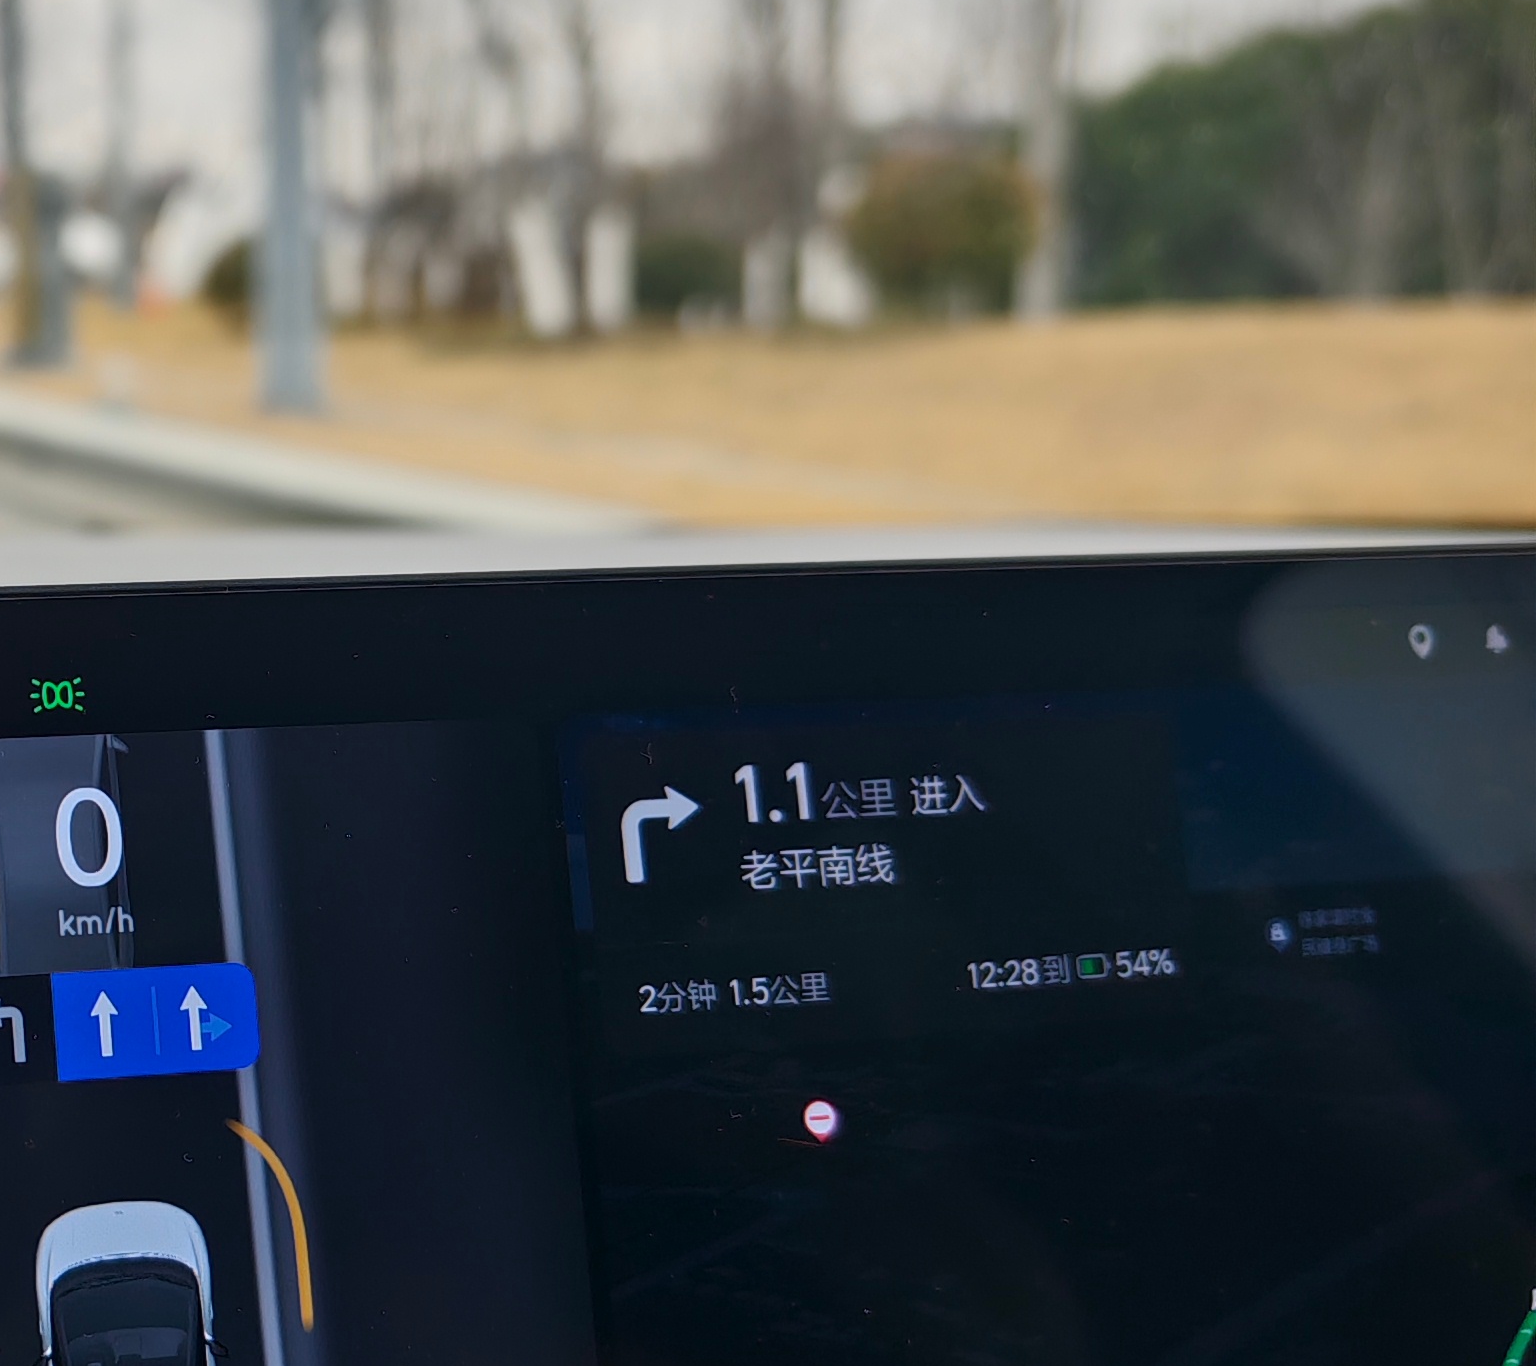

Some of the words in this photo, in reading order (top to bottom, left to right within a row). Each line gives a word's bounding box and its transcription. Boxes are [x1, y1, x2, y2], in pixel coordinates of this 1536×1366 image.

[909, 774, 988, 816] 进入
[55, 786, 123, 888] 0
[740, 845, 896, 890] 老平南线
[58, 906, 135, 937] km/h
[1115, 948, 1175, 978] 54%
[638, 980, 718, 1014] 2分钟
[728, 972, 831, 1007] 1.5公里
